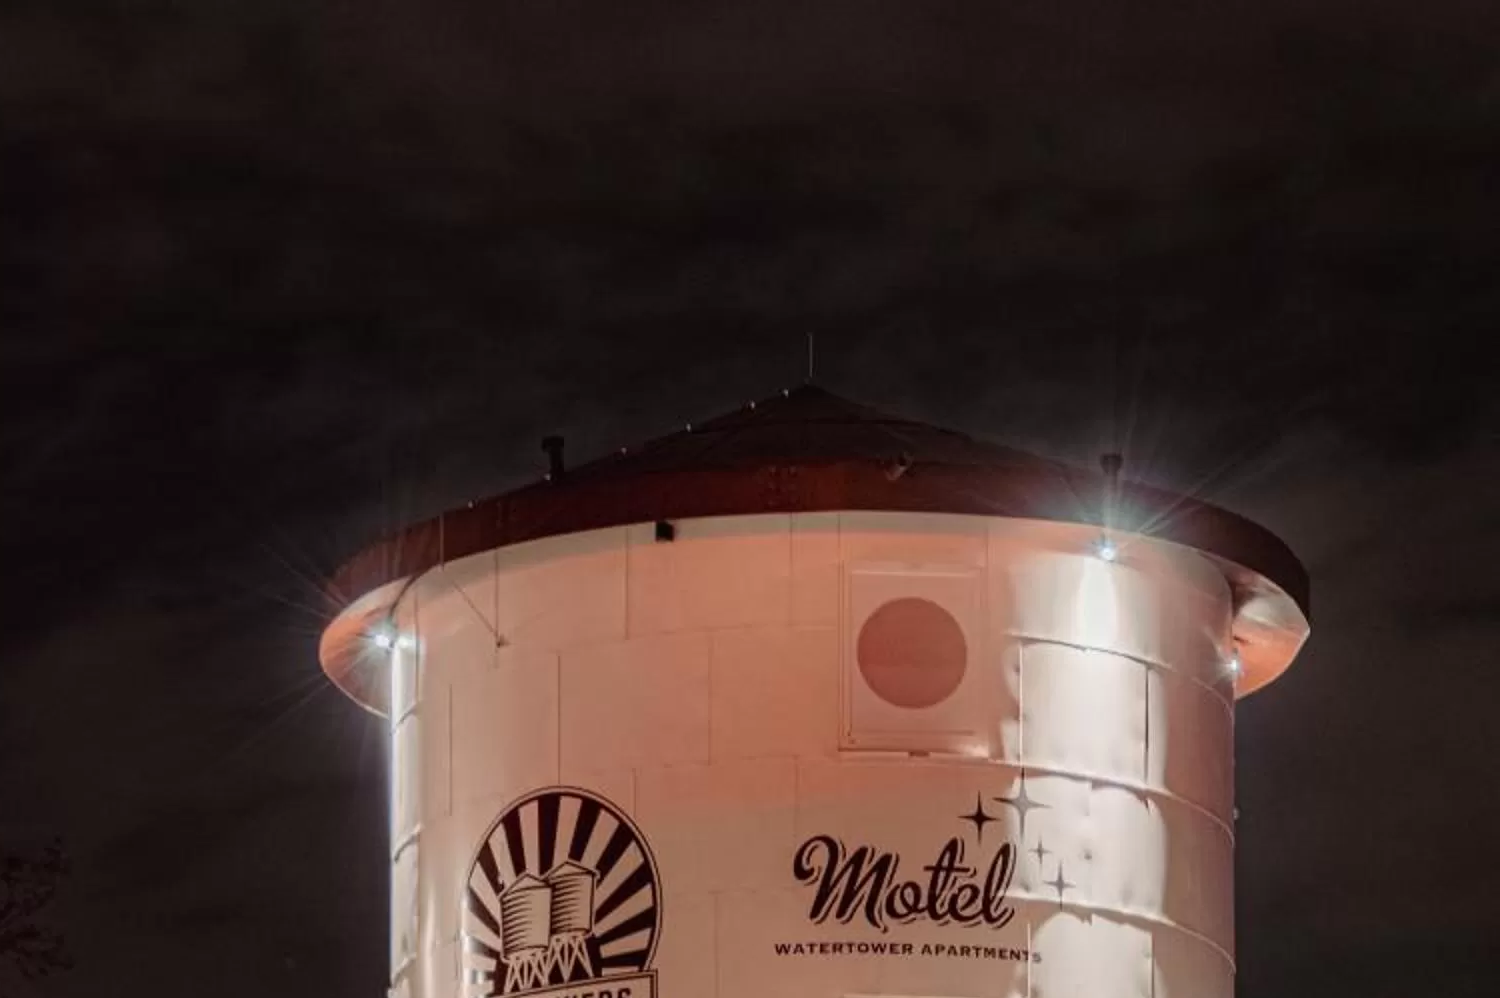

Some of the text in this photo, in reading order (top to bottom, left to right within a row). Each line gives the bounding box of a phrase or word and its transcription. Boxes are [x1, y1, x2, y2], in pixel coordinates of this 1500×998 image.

[793, 834, 1017, 934] Motel
[774, 942, 1042, 963] WATERTOWER APARTMENTS
